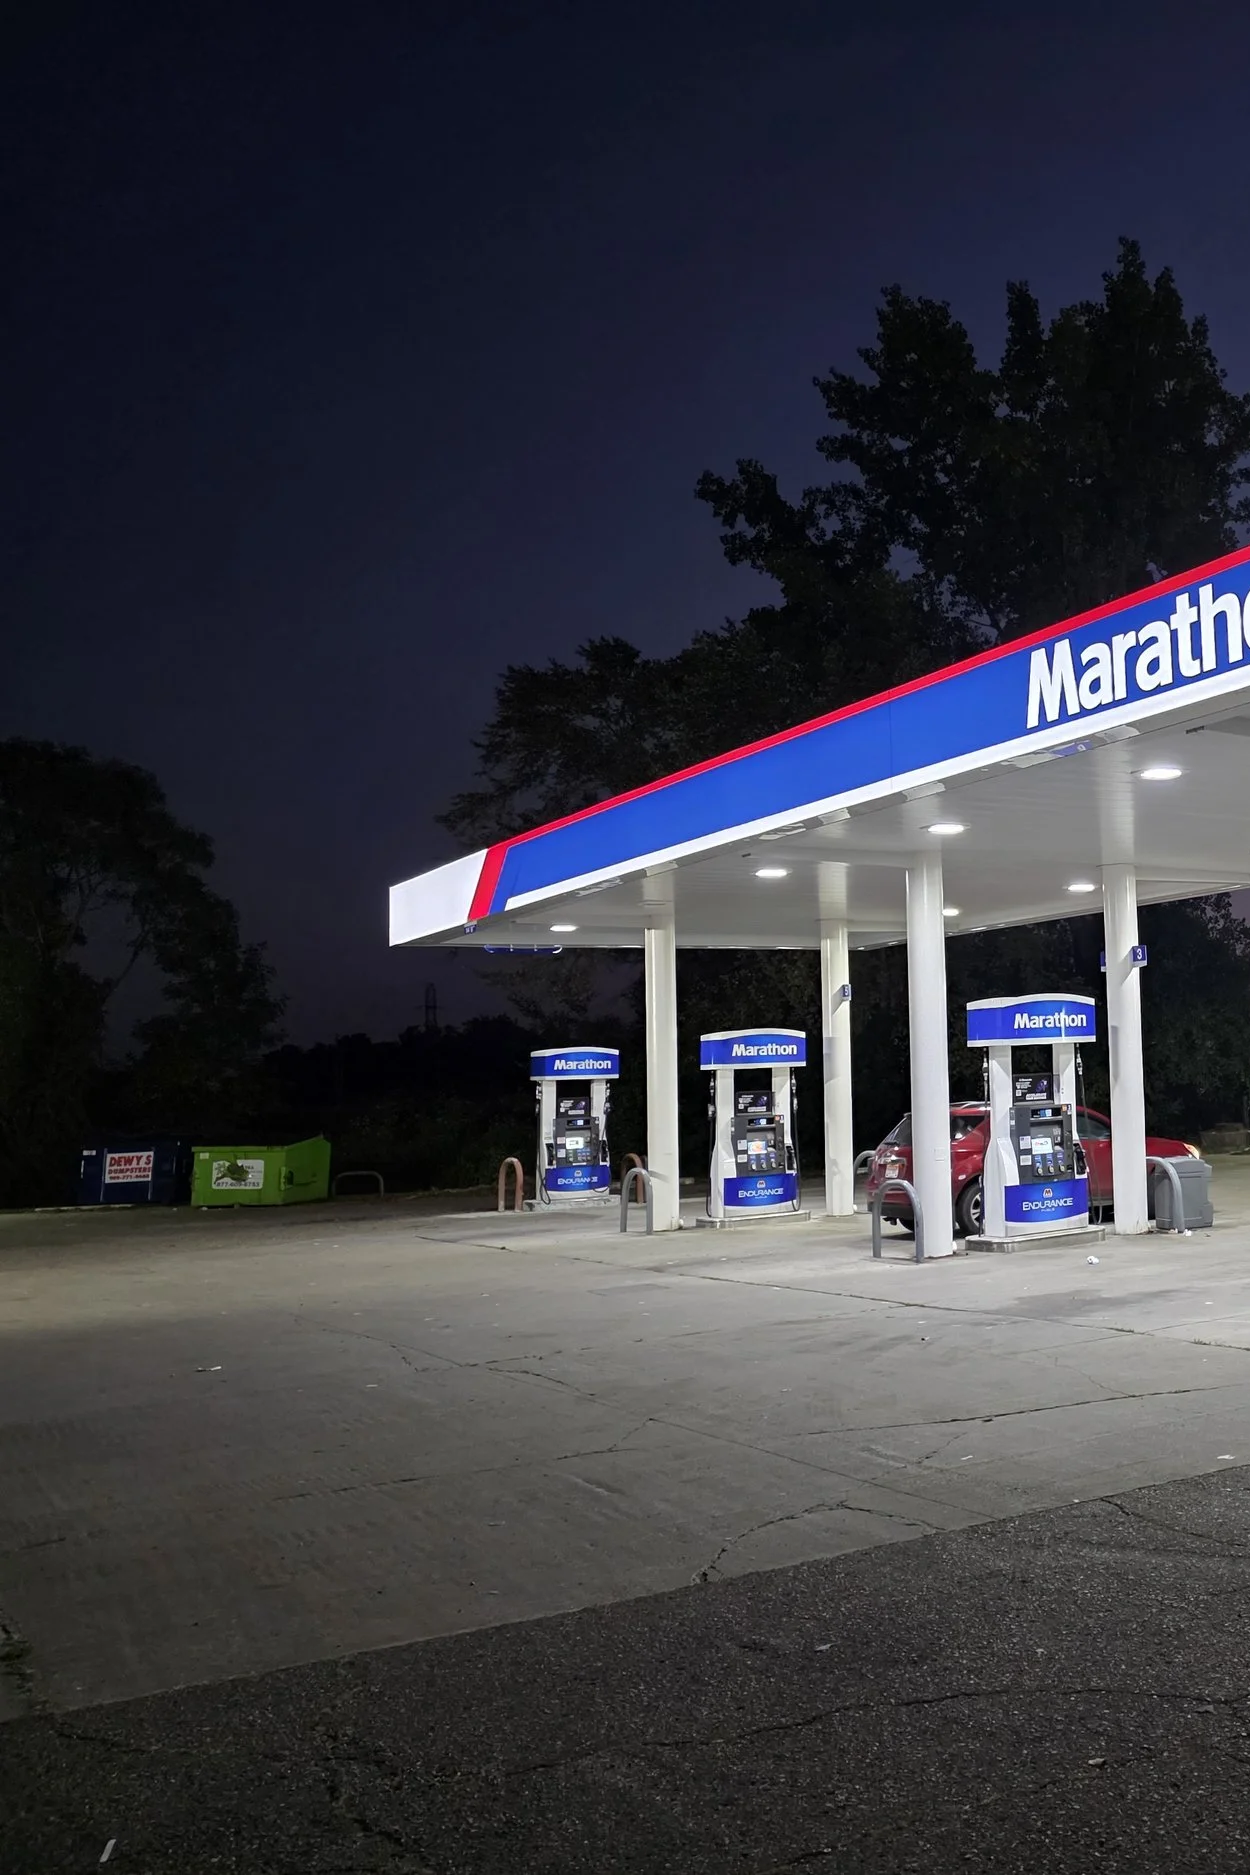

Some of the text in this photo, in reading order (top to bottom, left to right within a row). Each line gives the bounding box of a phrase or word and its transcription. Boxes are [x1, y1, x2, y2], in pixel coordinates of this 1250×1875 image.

[1136, 948, 1143, 960] 3
[1014, 1012, 1086, 1029] Marathon
[732, 1043, 797, 1057] Marathon
[554, 1059, 611, 1070] Marathon
[109, 1154, 152, 1167] DEWY S
[108, 1167, 152, 1175] DUMPSTERS
[738, 1187, 784, 1198] ENDURANCE
[1022, 1197, 1074, 1211] ENDURANCE
